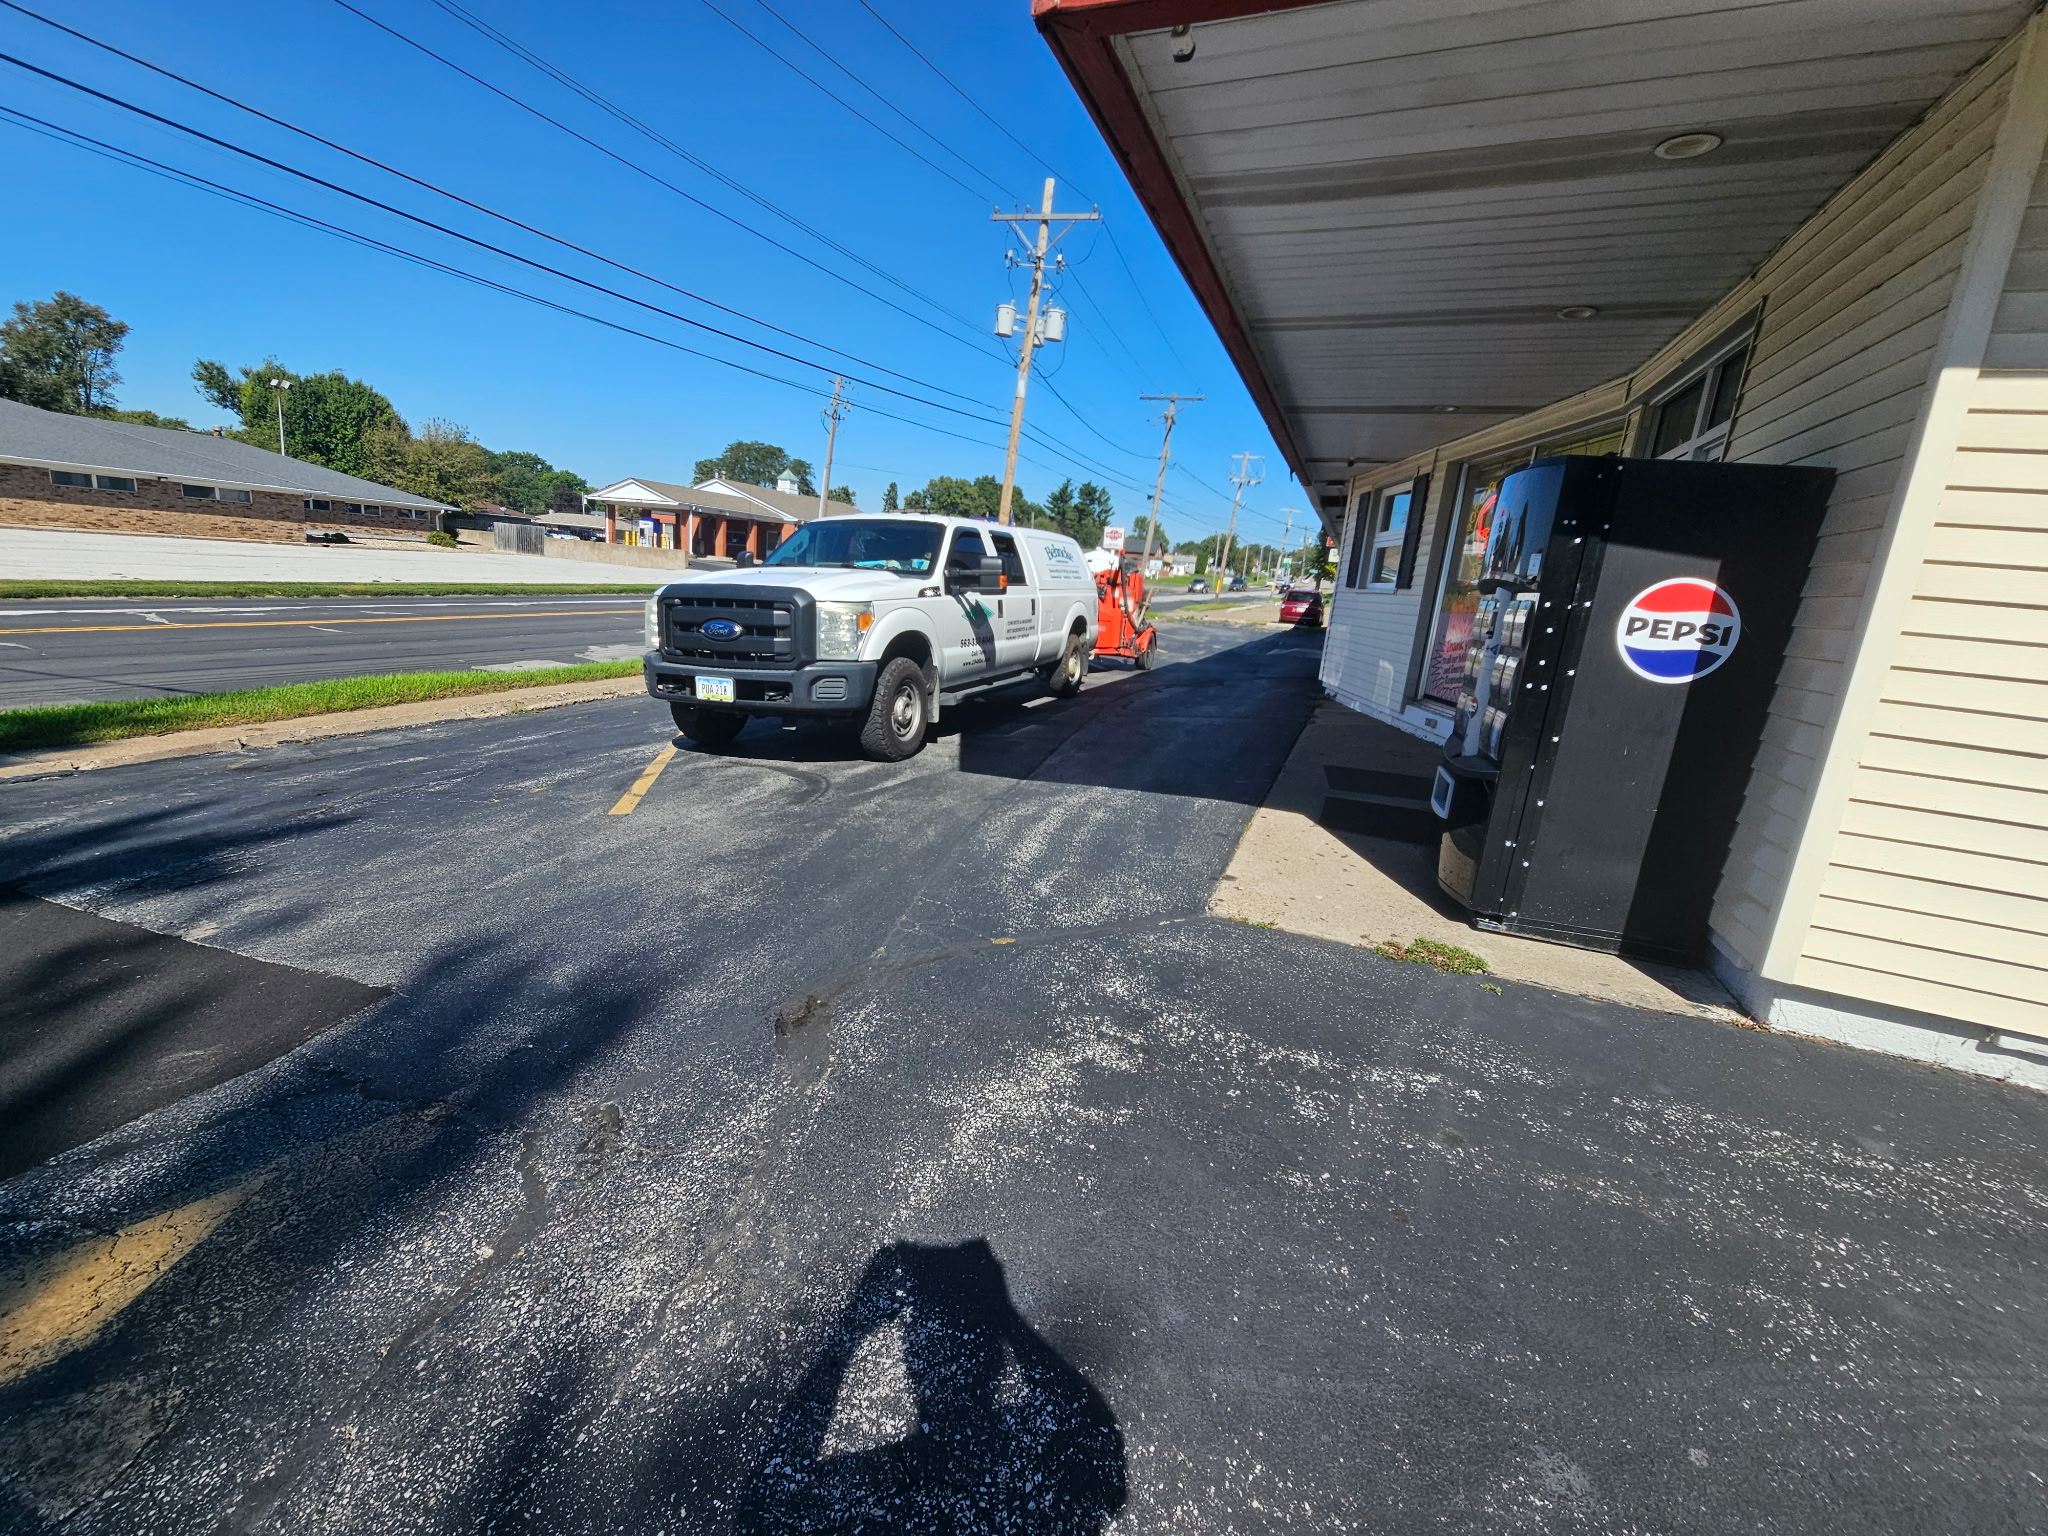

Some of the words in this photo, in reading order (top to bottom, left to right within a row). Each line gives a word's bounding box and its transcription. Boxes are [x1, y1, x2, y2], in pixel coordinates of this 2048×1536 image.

[708, 623, 730, 636] Ford
[1625, 616, 1733, 647] PEPSI
[702, 684, 713, 694] PUA
